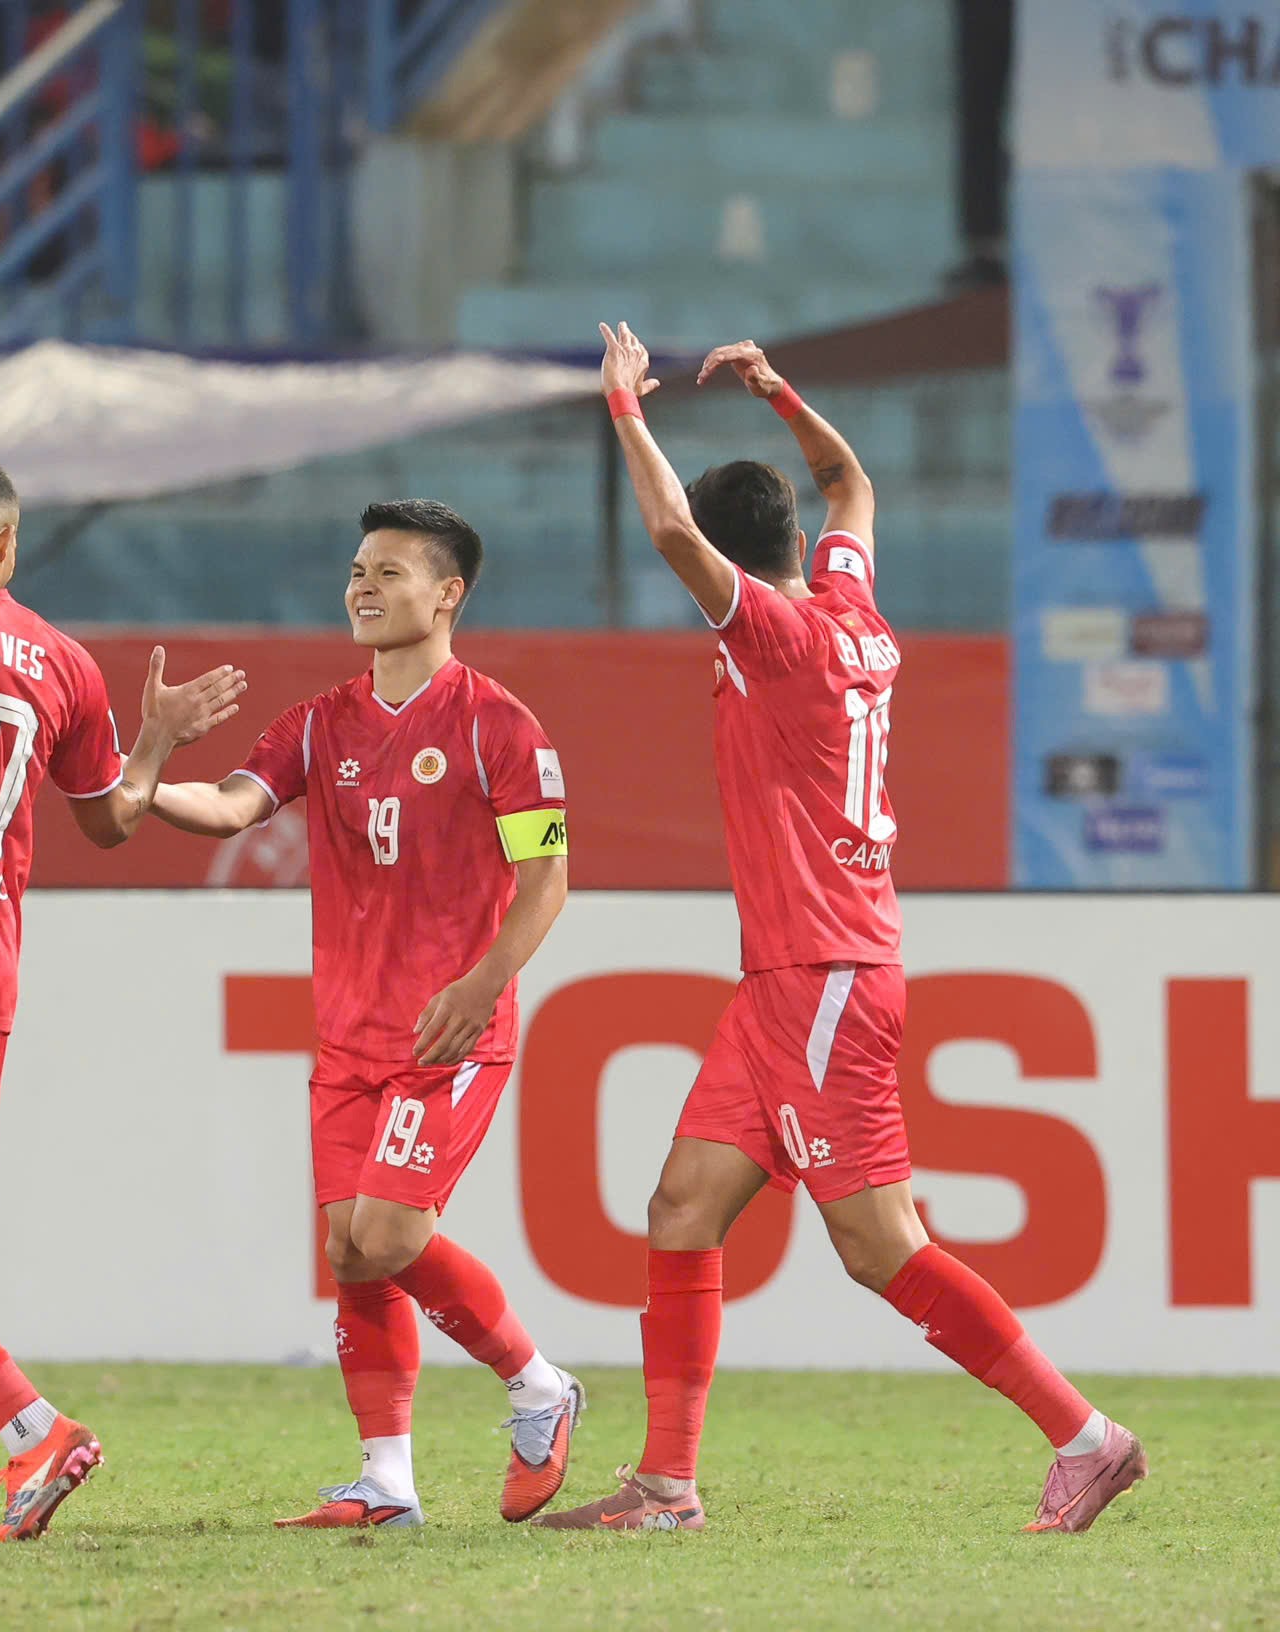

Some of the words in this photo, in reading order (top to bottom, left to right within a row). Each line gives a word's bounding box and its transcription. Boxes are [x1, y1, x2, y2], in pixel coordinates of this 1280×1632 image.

[1141, 17, 1280, 87] CH
[368, 796, 401, 866] 19
[540, 821, 566, 847] AF
[222, 970, 1280, 1312] OS
[374, 1095, 426, 1168] 19
[777, 1103, 810, 1170] 0
